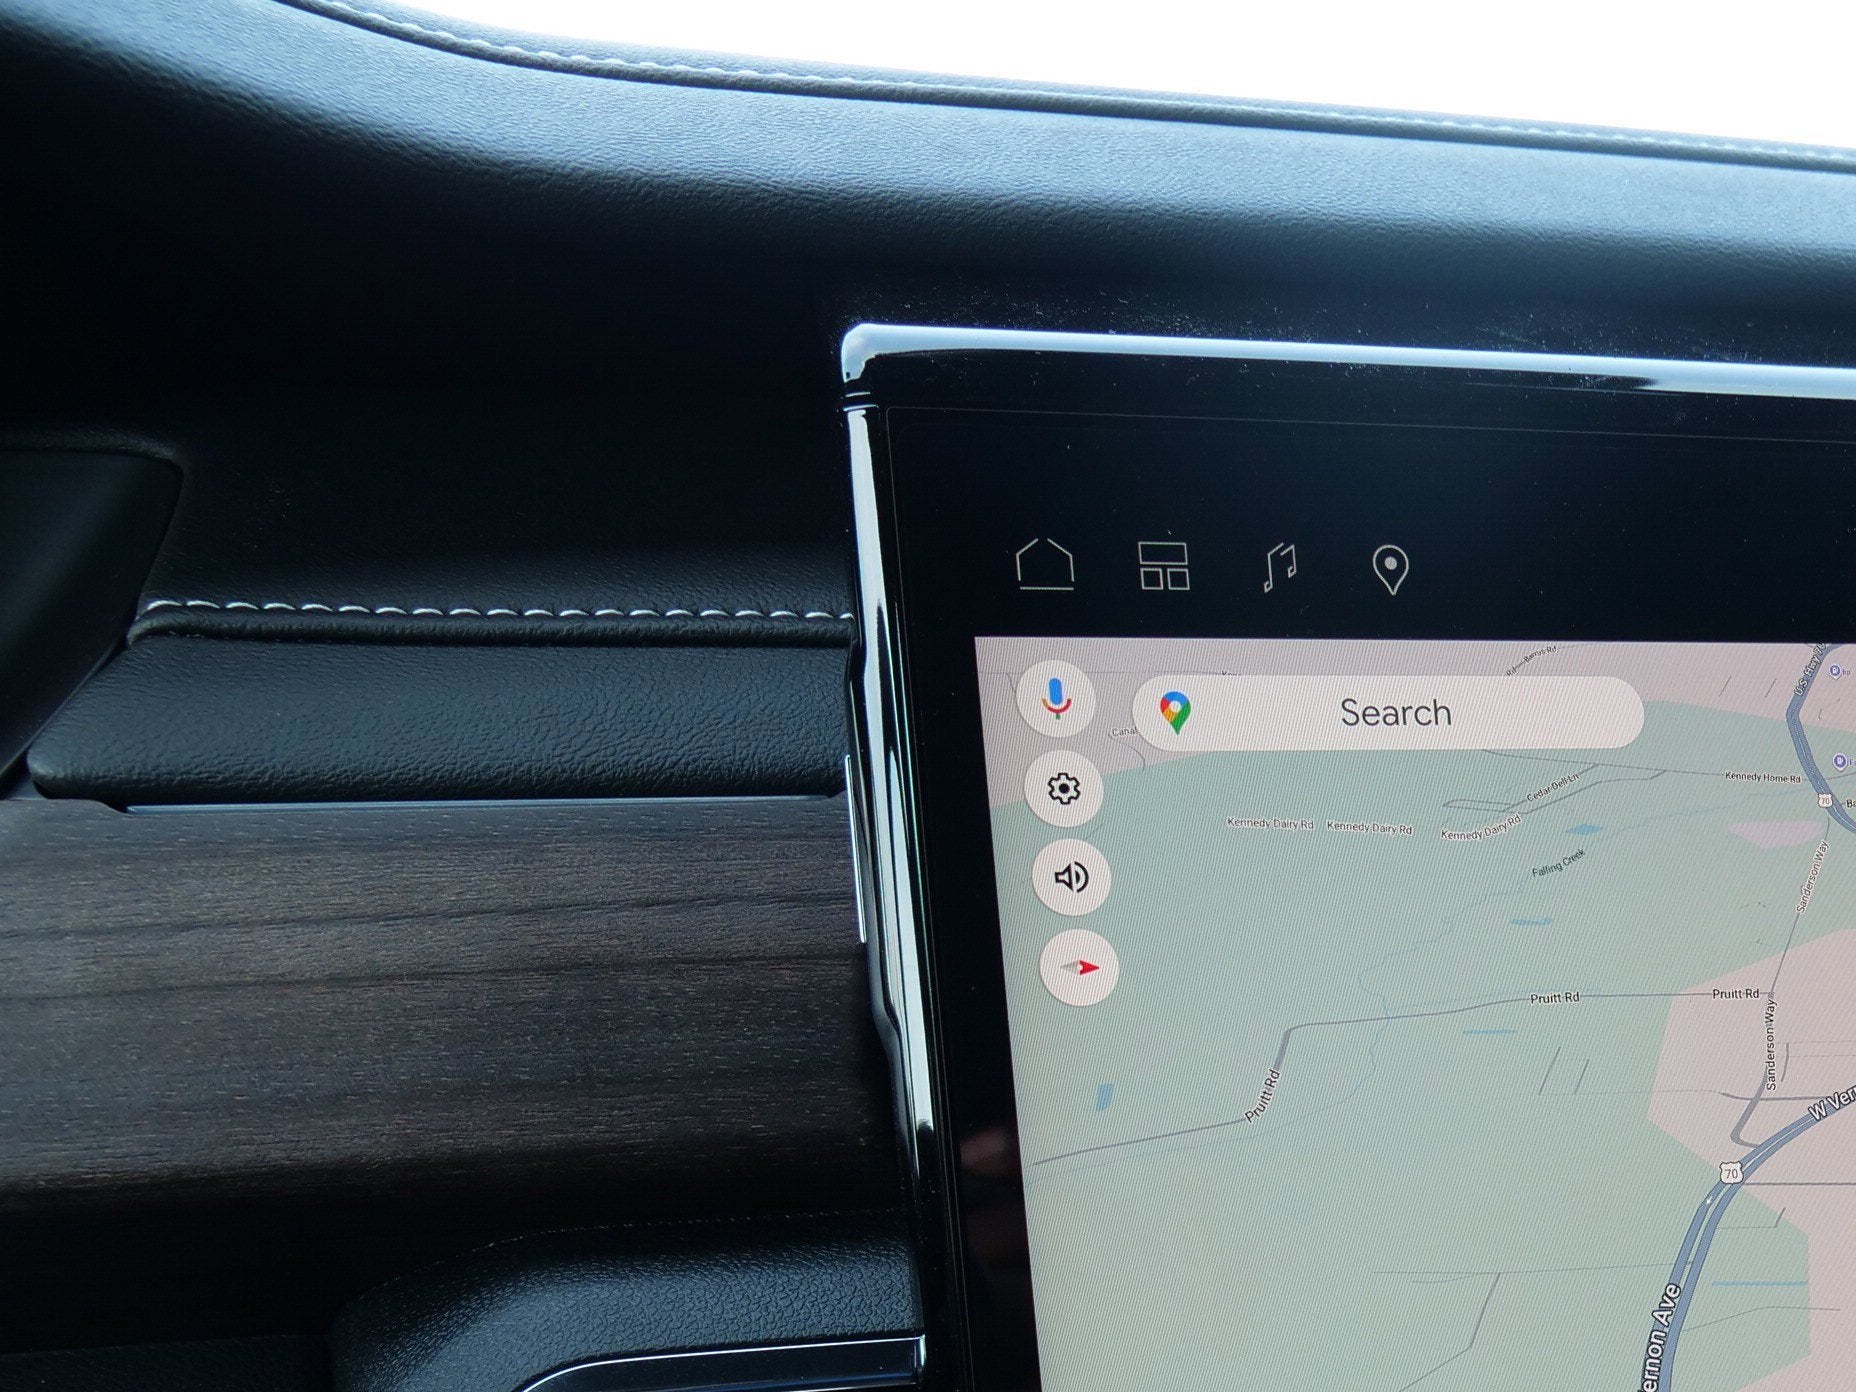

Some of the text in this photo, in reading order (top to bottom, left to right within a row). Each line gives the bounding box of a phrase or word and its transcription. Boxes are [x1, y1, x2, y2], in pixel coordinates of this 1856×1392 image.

[1547, 645, 1558, 654] Rd
[1341, 698, 1452, 729] Search
[1725, 772, 1801, 784] Kennedy Home Rd
[1526, 785, 1551, 802] Cedar
[1227, 817, 1314, 830] Kennedy Dairy Rd
[1327, 821, 1412, 835] Kennedy Dairy Rd
[1440, 814, 1522, 841] Kennedy Dairy Rd
[1532, 849, 1586, 878] Falling Creek
[1796, 841, 1829, 913] Sanderson Way
[1530, 991, 1580, 1004] Pruitt Rd
[1713, 988, 1760, 999] Pruitt Rd
[1765, 999, 1778, 1090] Sanderson Way
[1245, 1069, 1280, 1123] Pruitt Rd
[1808, 1101, 1829, 1121] W
[1725, 1168, 1738, 1180] 70
[1652, 1283, 1681, 1327] Ave
